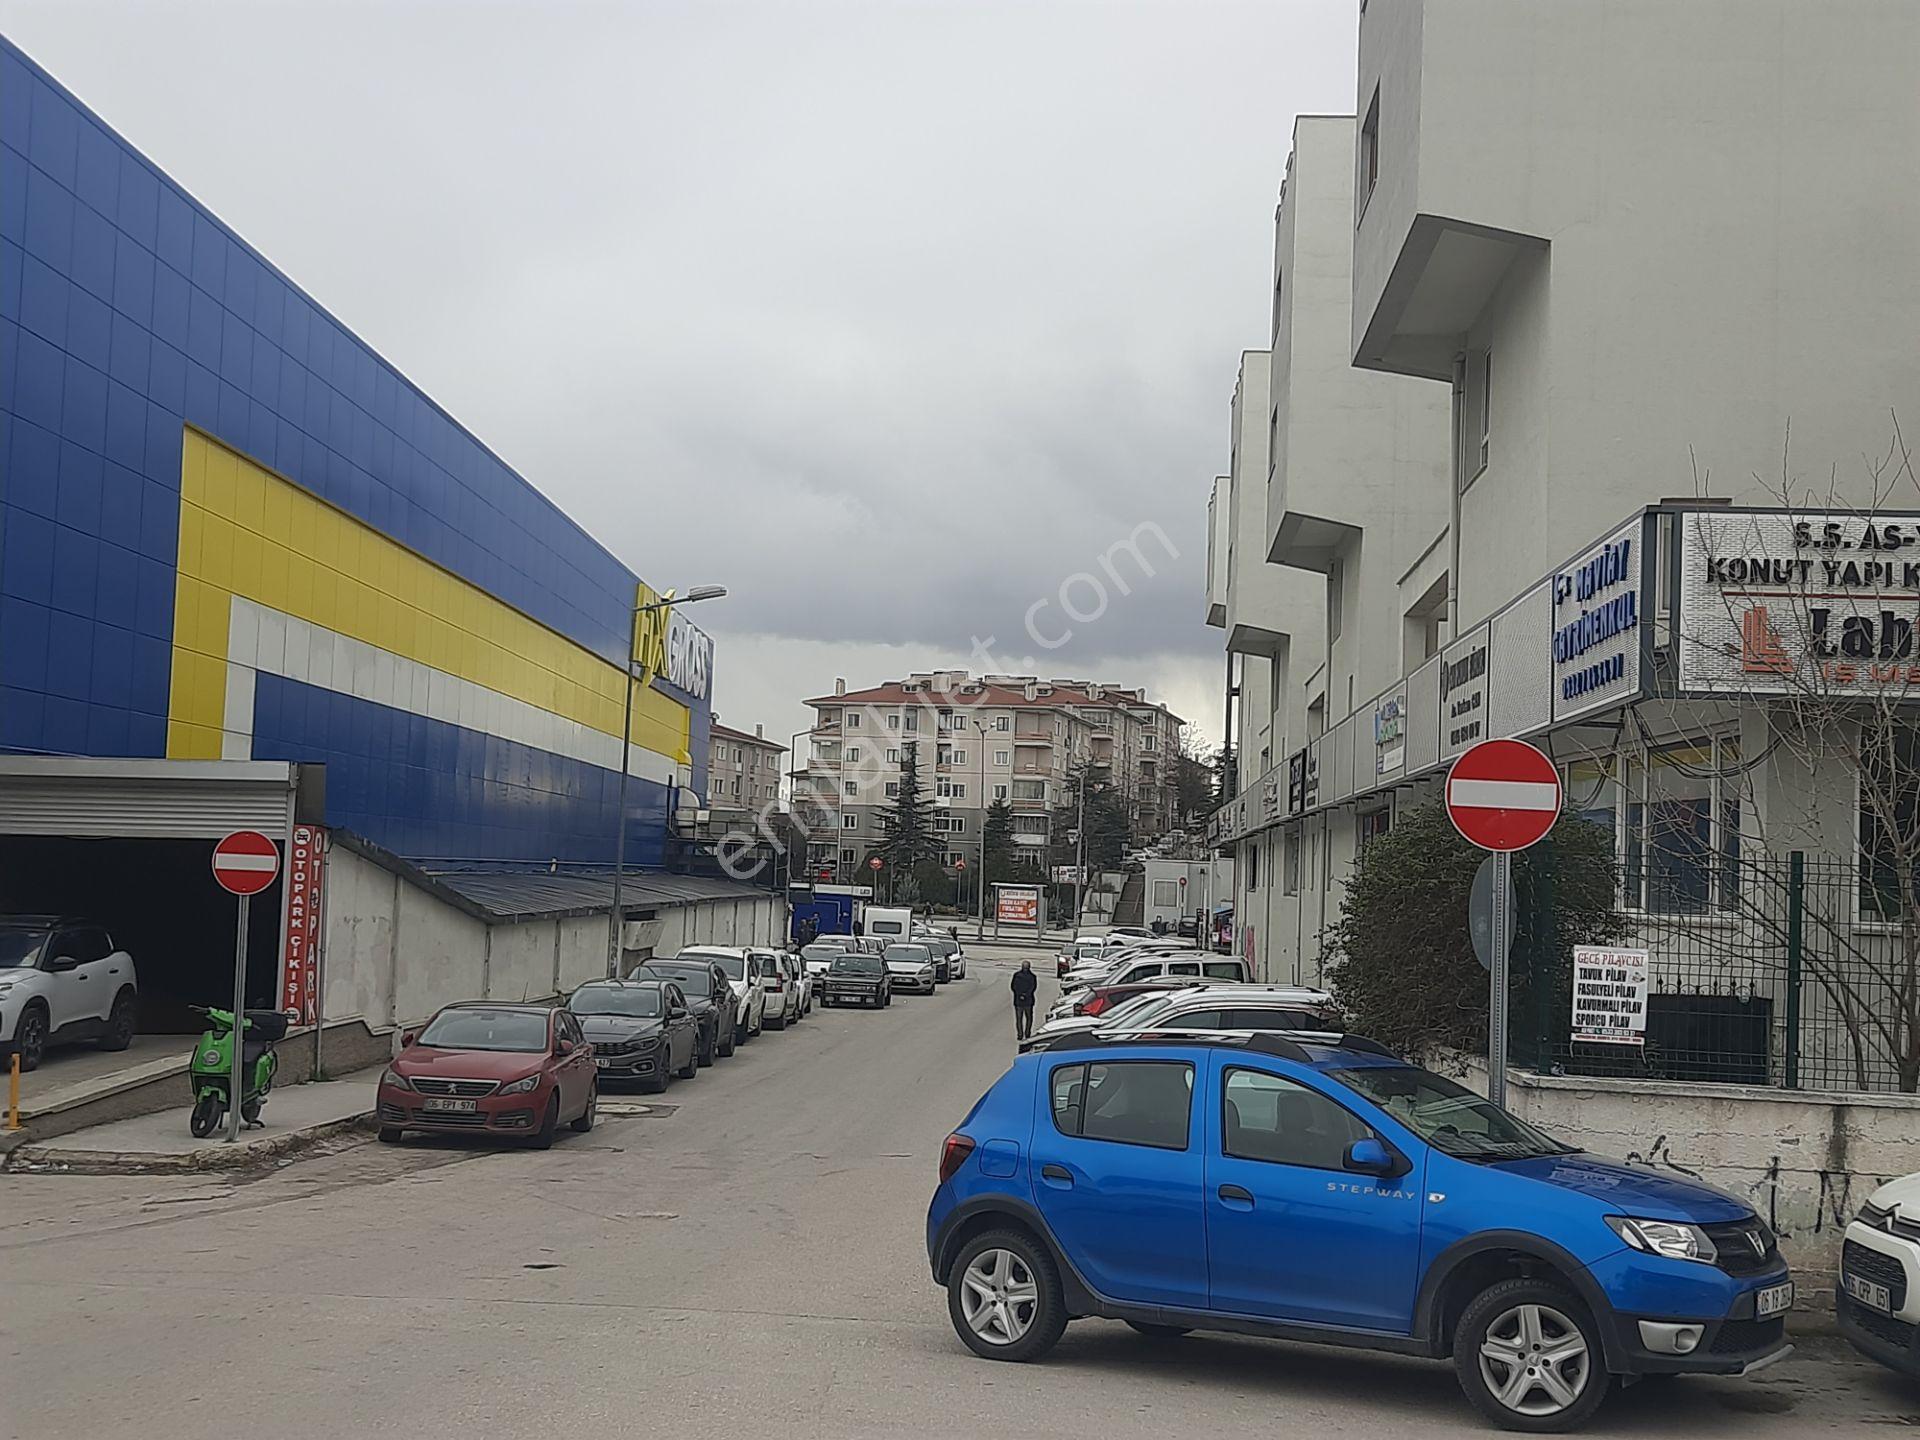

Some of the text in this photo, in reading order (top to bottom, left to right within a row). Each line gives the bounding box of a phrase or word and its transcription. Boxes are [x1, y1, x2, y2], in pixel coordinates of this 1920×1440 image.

[1858, 524, 1920, 549] AS-
[1707, 558, 1813, 583] KONUT
[1820, 560, 1893, 587] YAPI
[291, 849, 307, 928] OTOPARK
[307, 832, 323, 1021] OTOPARK
[1577, 952, 1600, 965] GECE
[1579, 967, 1627, 982] TAVUK PİLAV
[1577, 983, 1636, 998] FASULYELİ PİLAV
[1576, 998, 1642, 1014] KAVURMALI PİLAV
[1575, 1013, 1631, 1028] SPORCU PİLAV
[1327, 1182, 1415, 1200] STEPWAY
